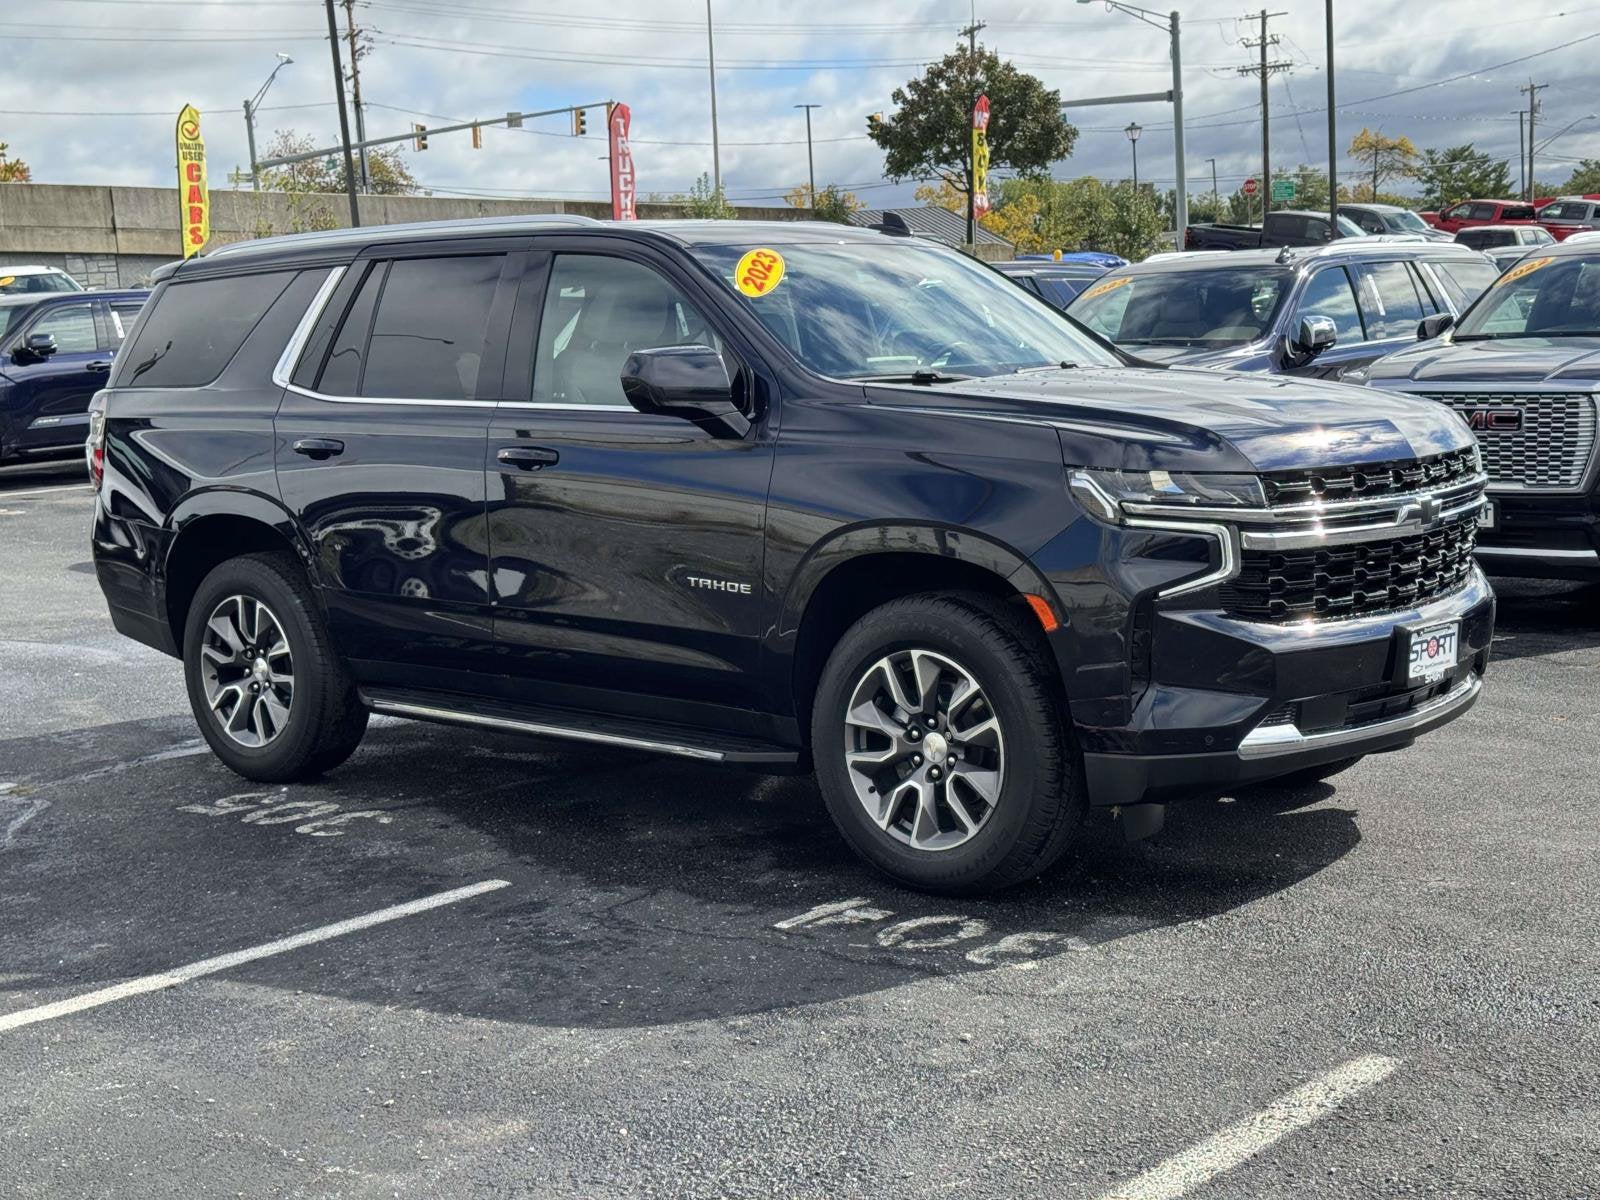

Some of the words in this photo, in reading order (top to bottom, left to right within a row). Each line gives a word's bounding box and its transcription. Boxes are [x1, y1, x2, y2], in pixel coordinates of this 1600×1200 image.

[182, 151, 204, 161] USED
[186, 163, 204, 245] CARS
[742, 251, 778, 292] 2023
[1455, 410, 1519, 429] MC
[686, 576, 752, 594] TAHOE
[1409, 632, 1456, 663] SPORT
